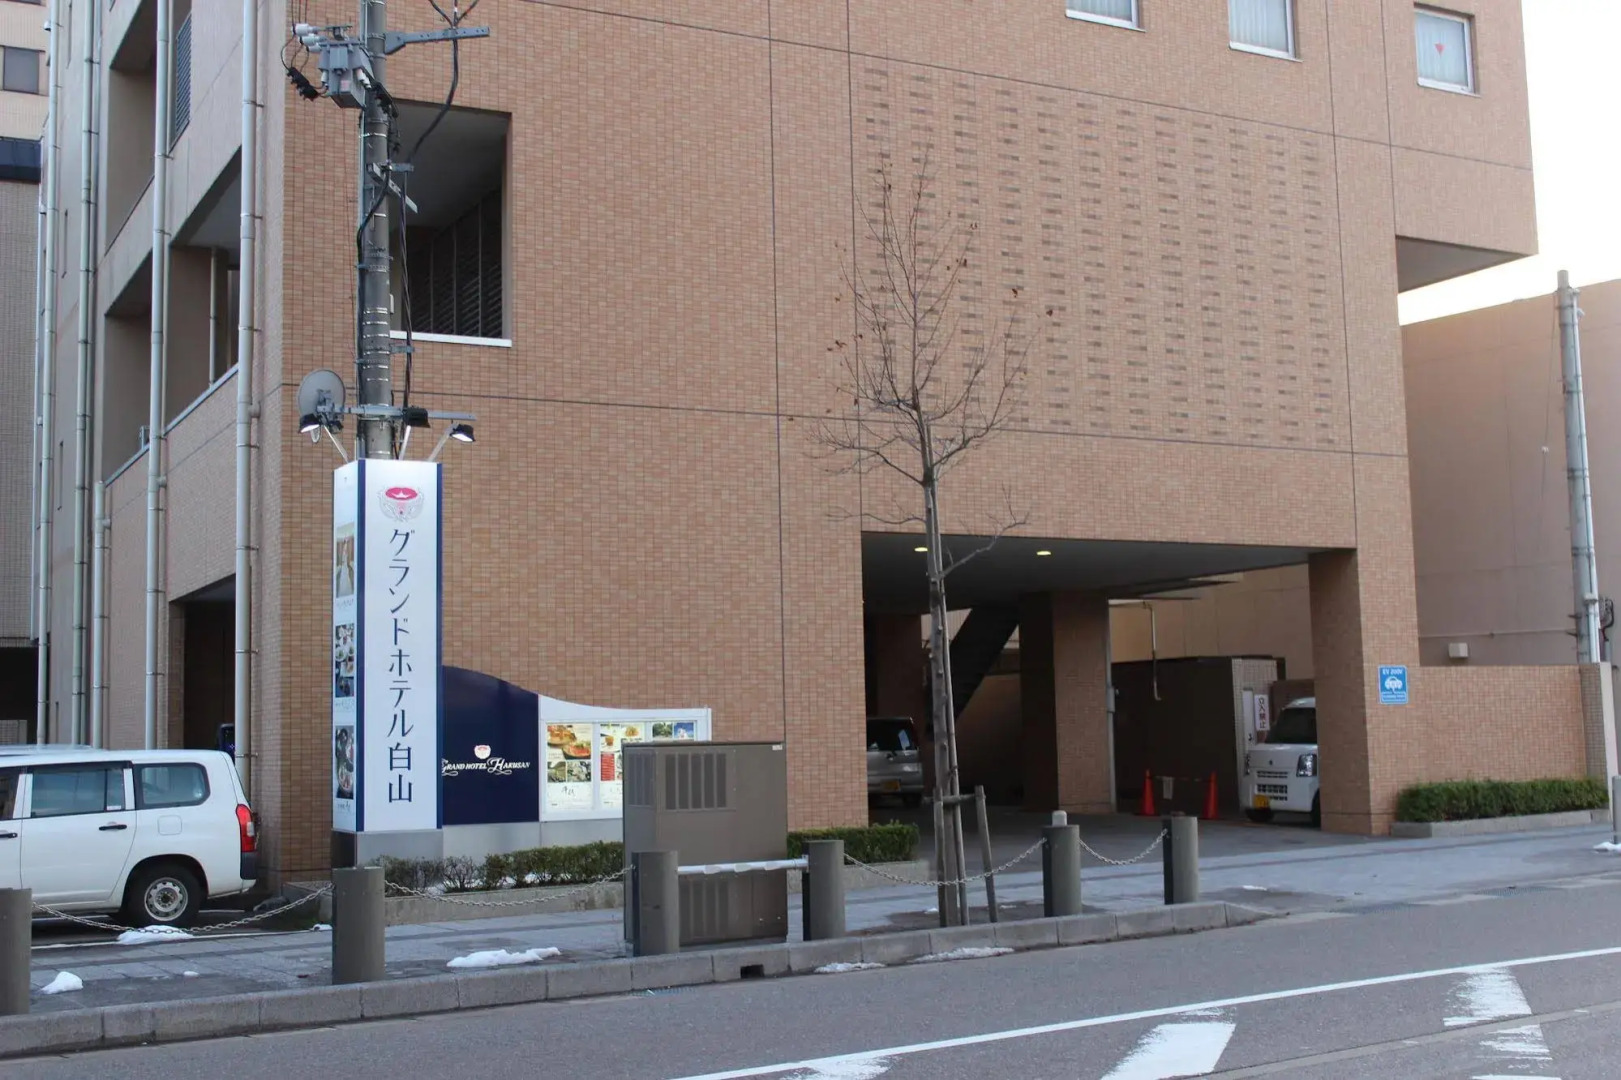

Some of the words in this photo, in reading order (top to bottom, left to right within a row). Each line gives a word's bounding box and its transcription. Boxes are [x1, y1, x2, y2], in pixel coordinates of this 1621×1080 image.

[387, 528, 416, 803] グランドホテル白山
[465, 762, 488, 770] HOTEL
[486, 757, 531, 776] HAKUSAN
